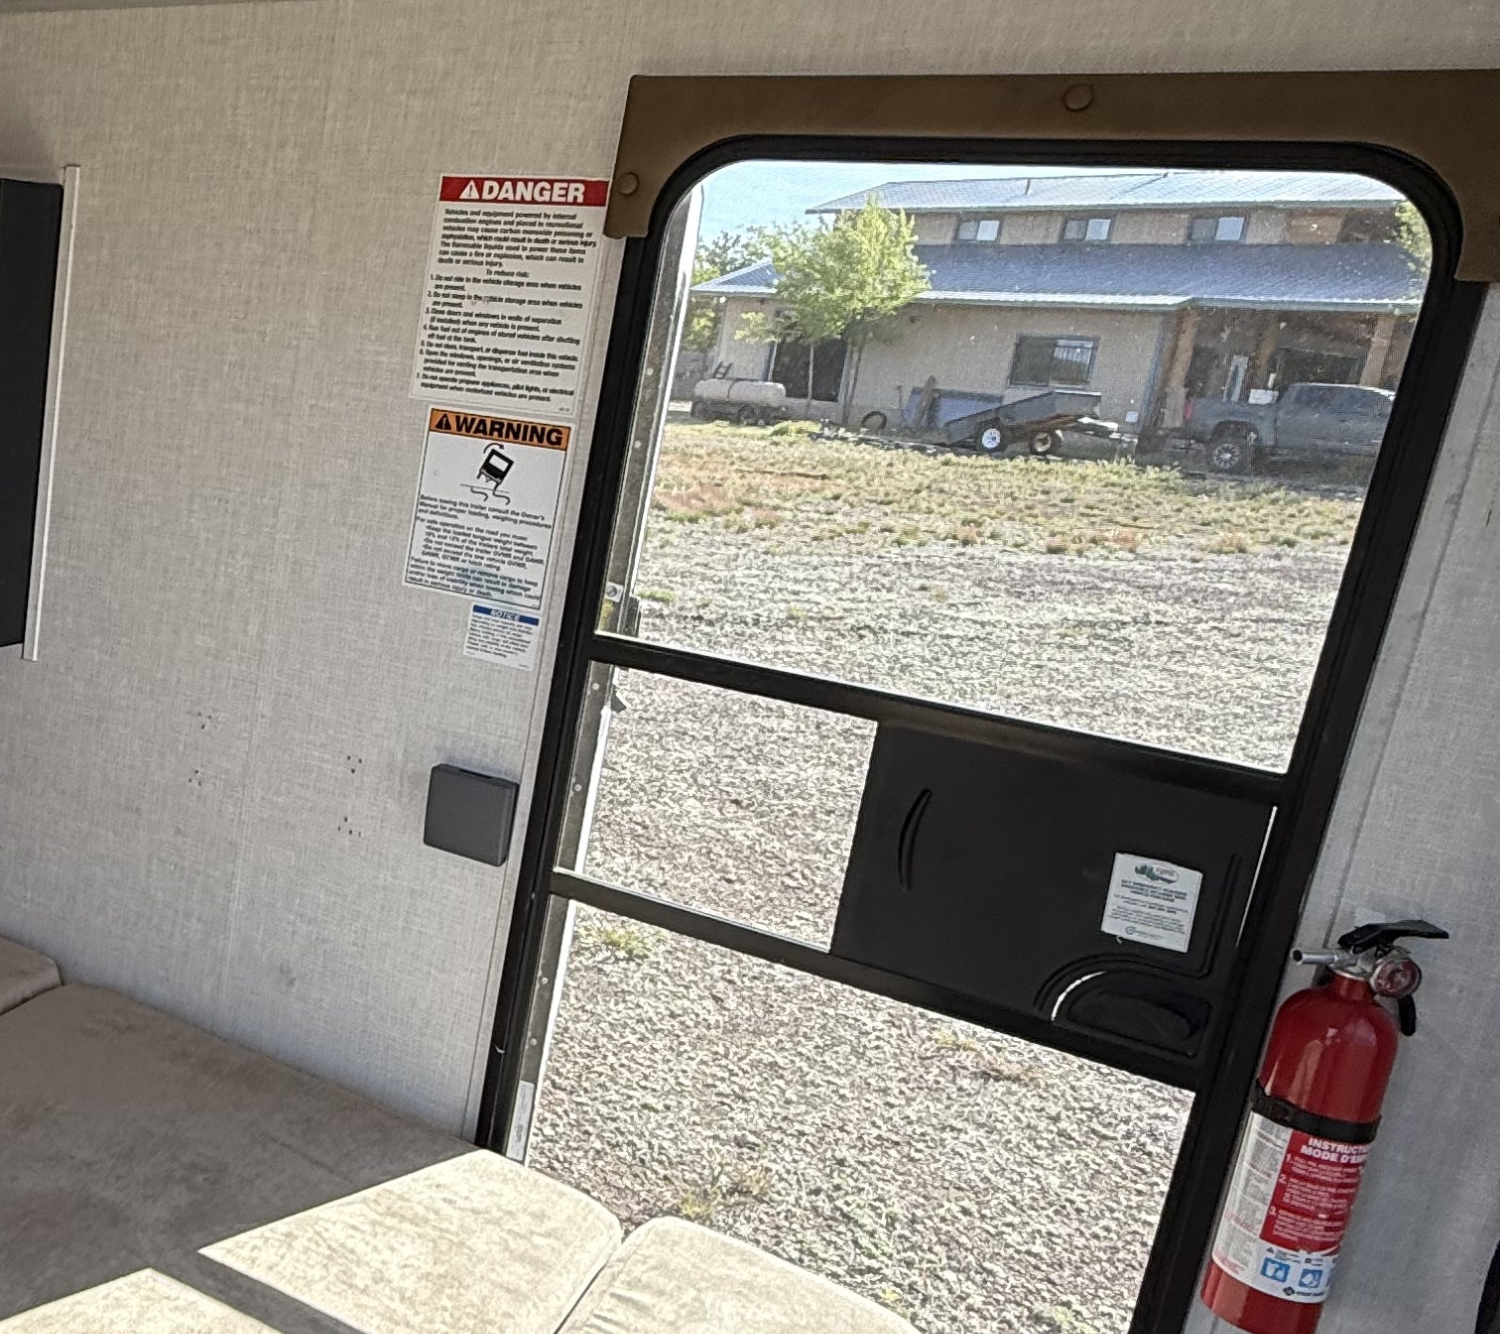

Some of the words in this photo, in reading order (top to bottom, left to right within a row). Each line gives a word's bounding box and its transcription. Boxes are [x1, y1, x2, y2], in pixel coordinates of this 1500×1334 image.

[481, 180, 585, 203] DANGER
[453, 415, 563, 446] WARNING
[1300, 1144, 1339, 1162] MODE
